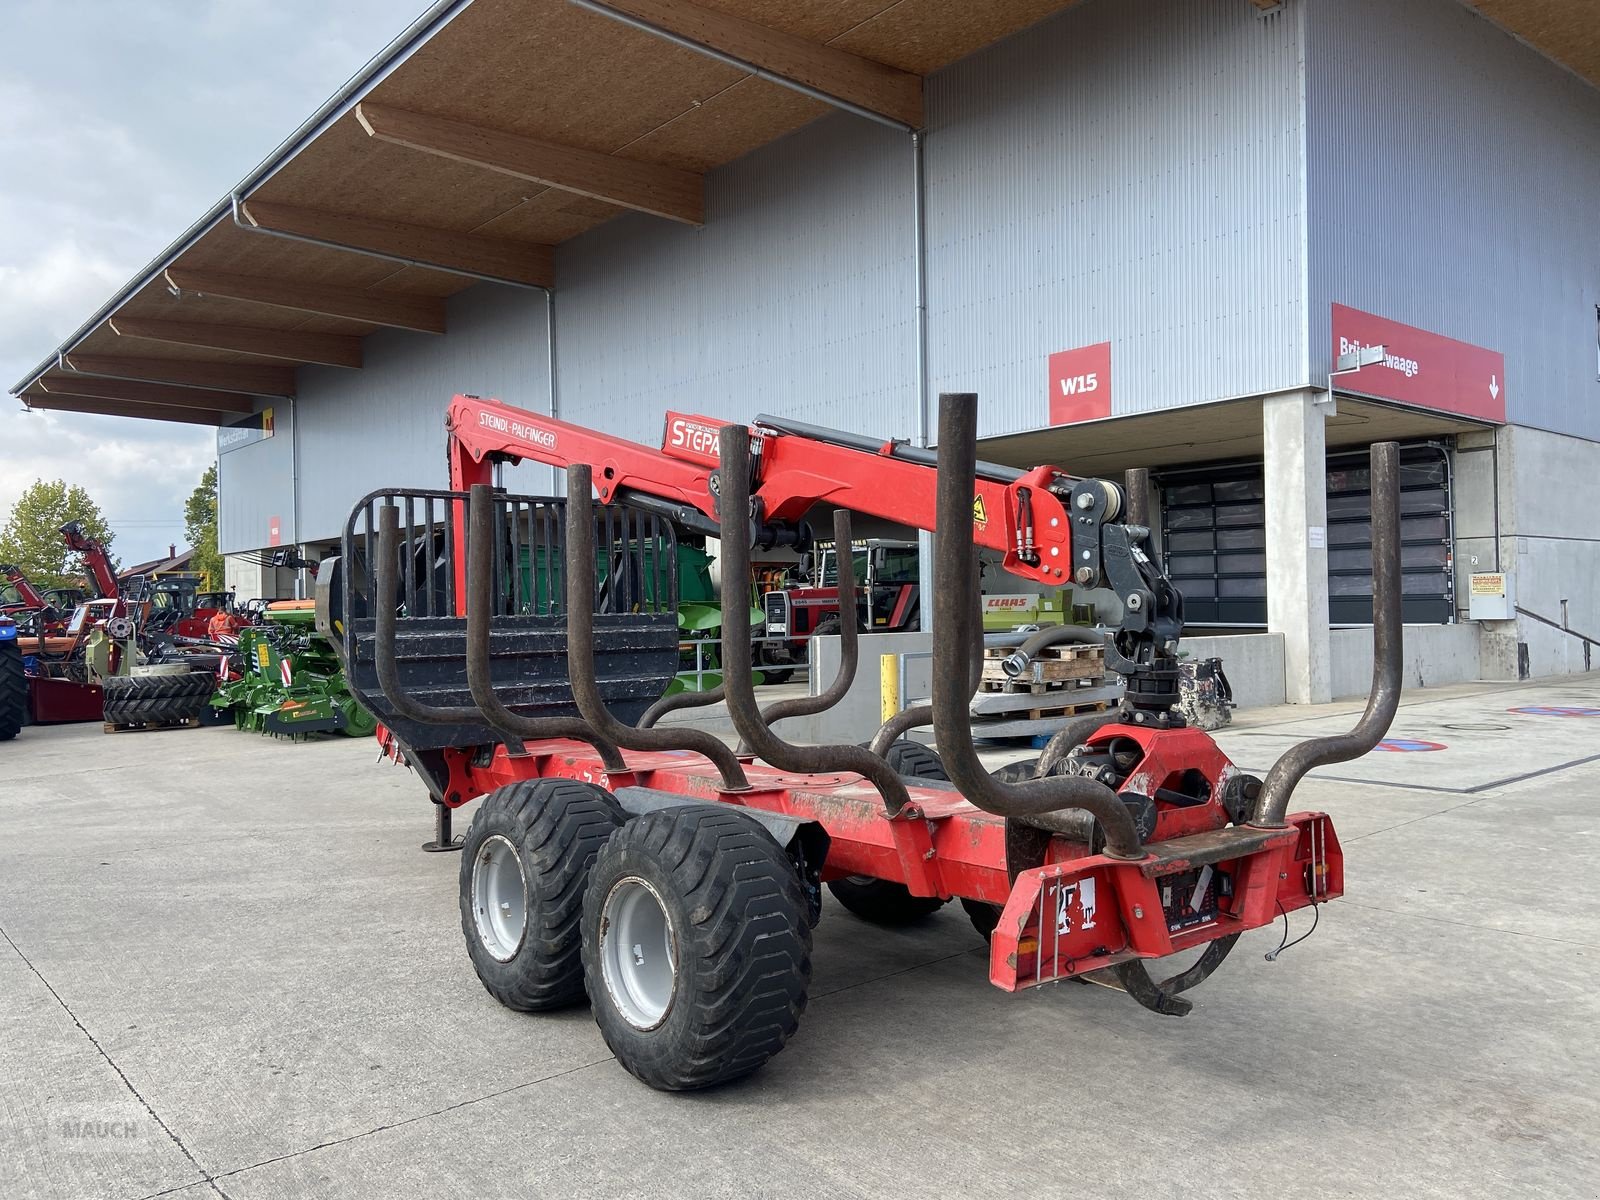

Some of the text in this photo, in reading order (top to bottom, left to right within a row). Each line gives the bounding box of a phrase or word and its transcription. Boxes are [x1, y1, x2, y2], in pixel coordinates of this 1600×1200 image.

[1340, 336, 1418, 377] Brüwaage
[1060, 373, 1098, 396] W15
[479, 412, 555, 448] STEINDL-PALFINGER
[671, 420, 720, 456] STEPA
[987, 598, 1027, 608] CLAAS
